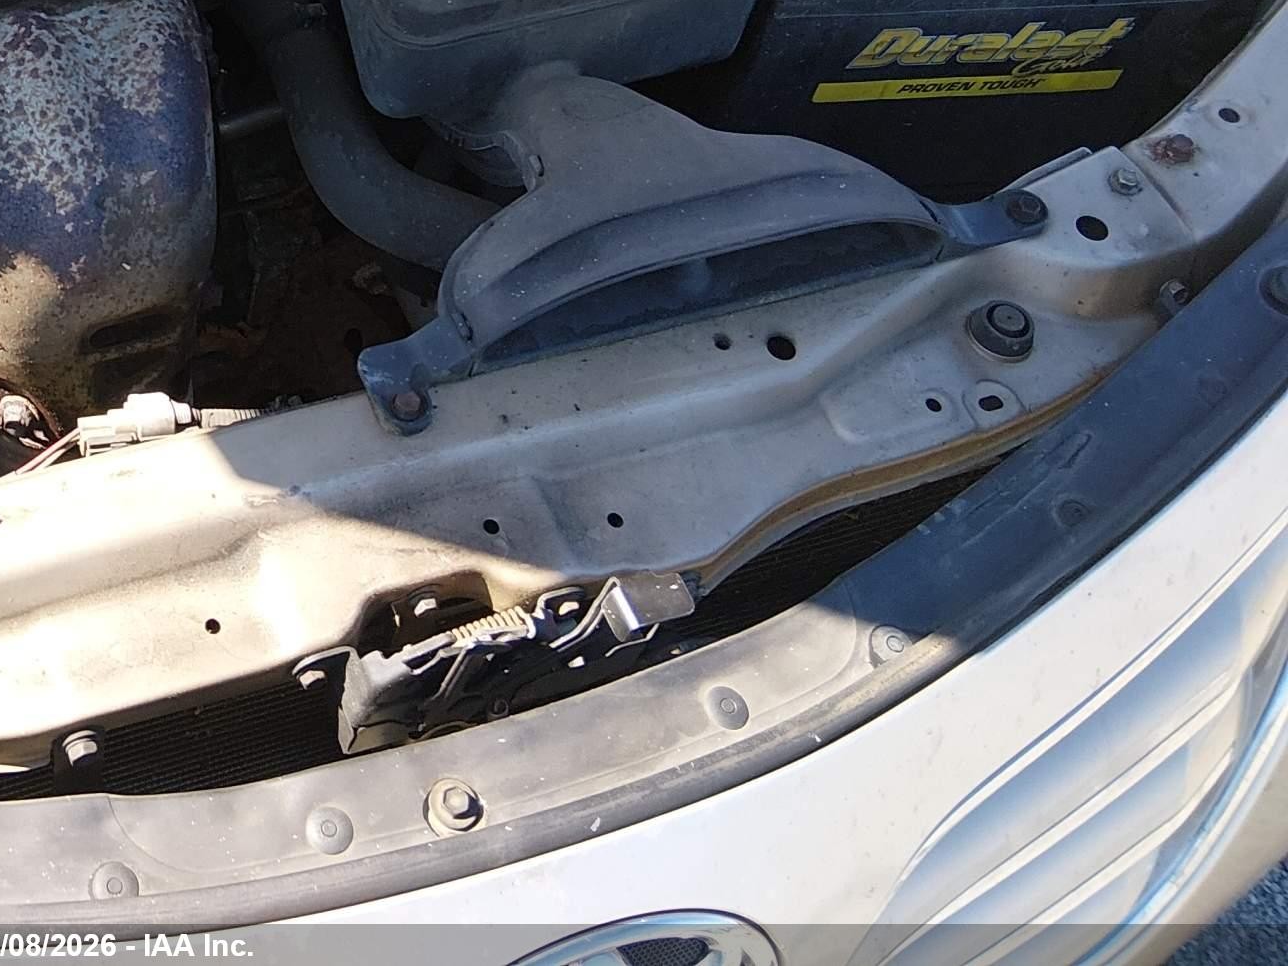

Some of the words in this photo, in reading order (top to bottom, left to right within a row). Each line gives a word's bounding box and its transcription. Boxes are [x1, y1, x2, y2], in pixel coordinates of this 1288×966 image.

[845, 17, 1136, 69] Duralast
[896, 80, 976, 95] PROVEN
[978, 77, 1043, 91] TOUGH
